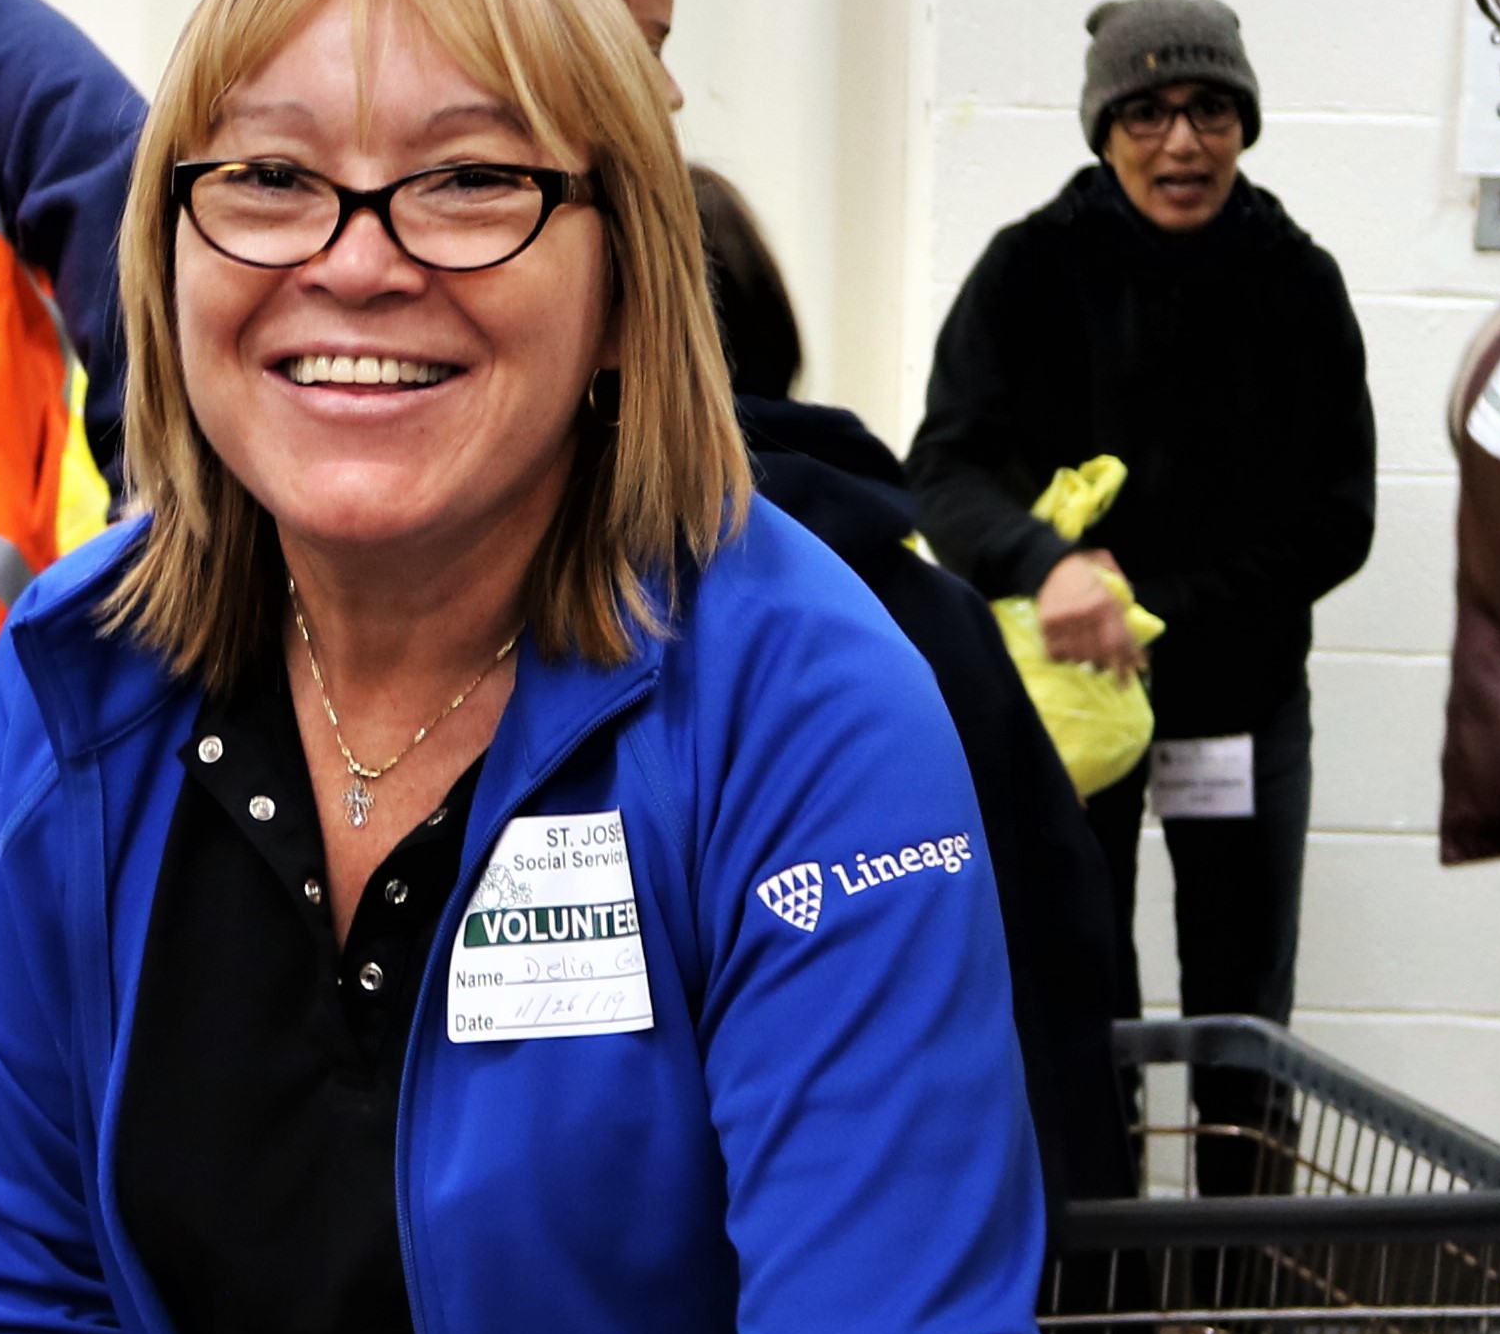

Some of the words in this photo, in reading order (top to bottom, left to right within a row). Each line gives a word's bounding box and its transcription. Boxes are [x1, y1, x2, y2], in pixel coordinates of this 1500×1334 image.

[546, 827, 574, 849] ST.
[513, 852, 568, 873] Social
[830, 835, 973, 896] Lineage
[455, 970, 504, 989] Name
[455, 1013, 494, 1033] Date
